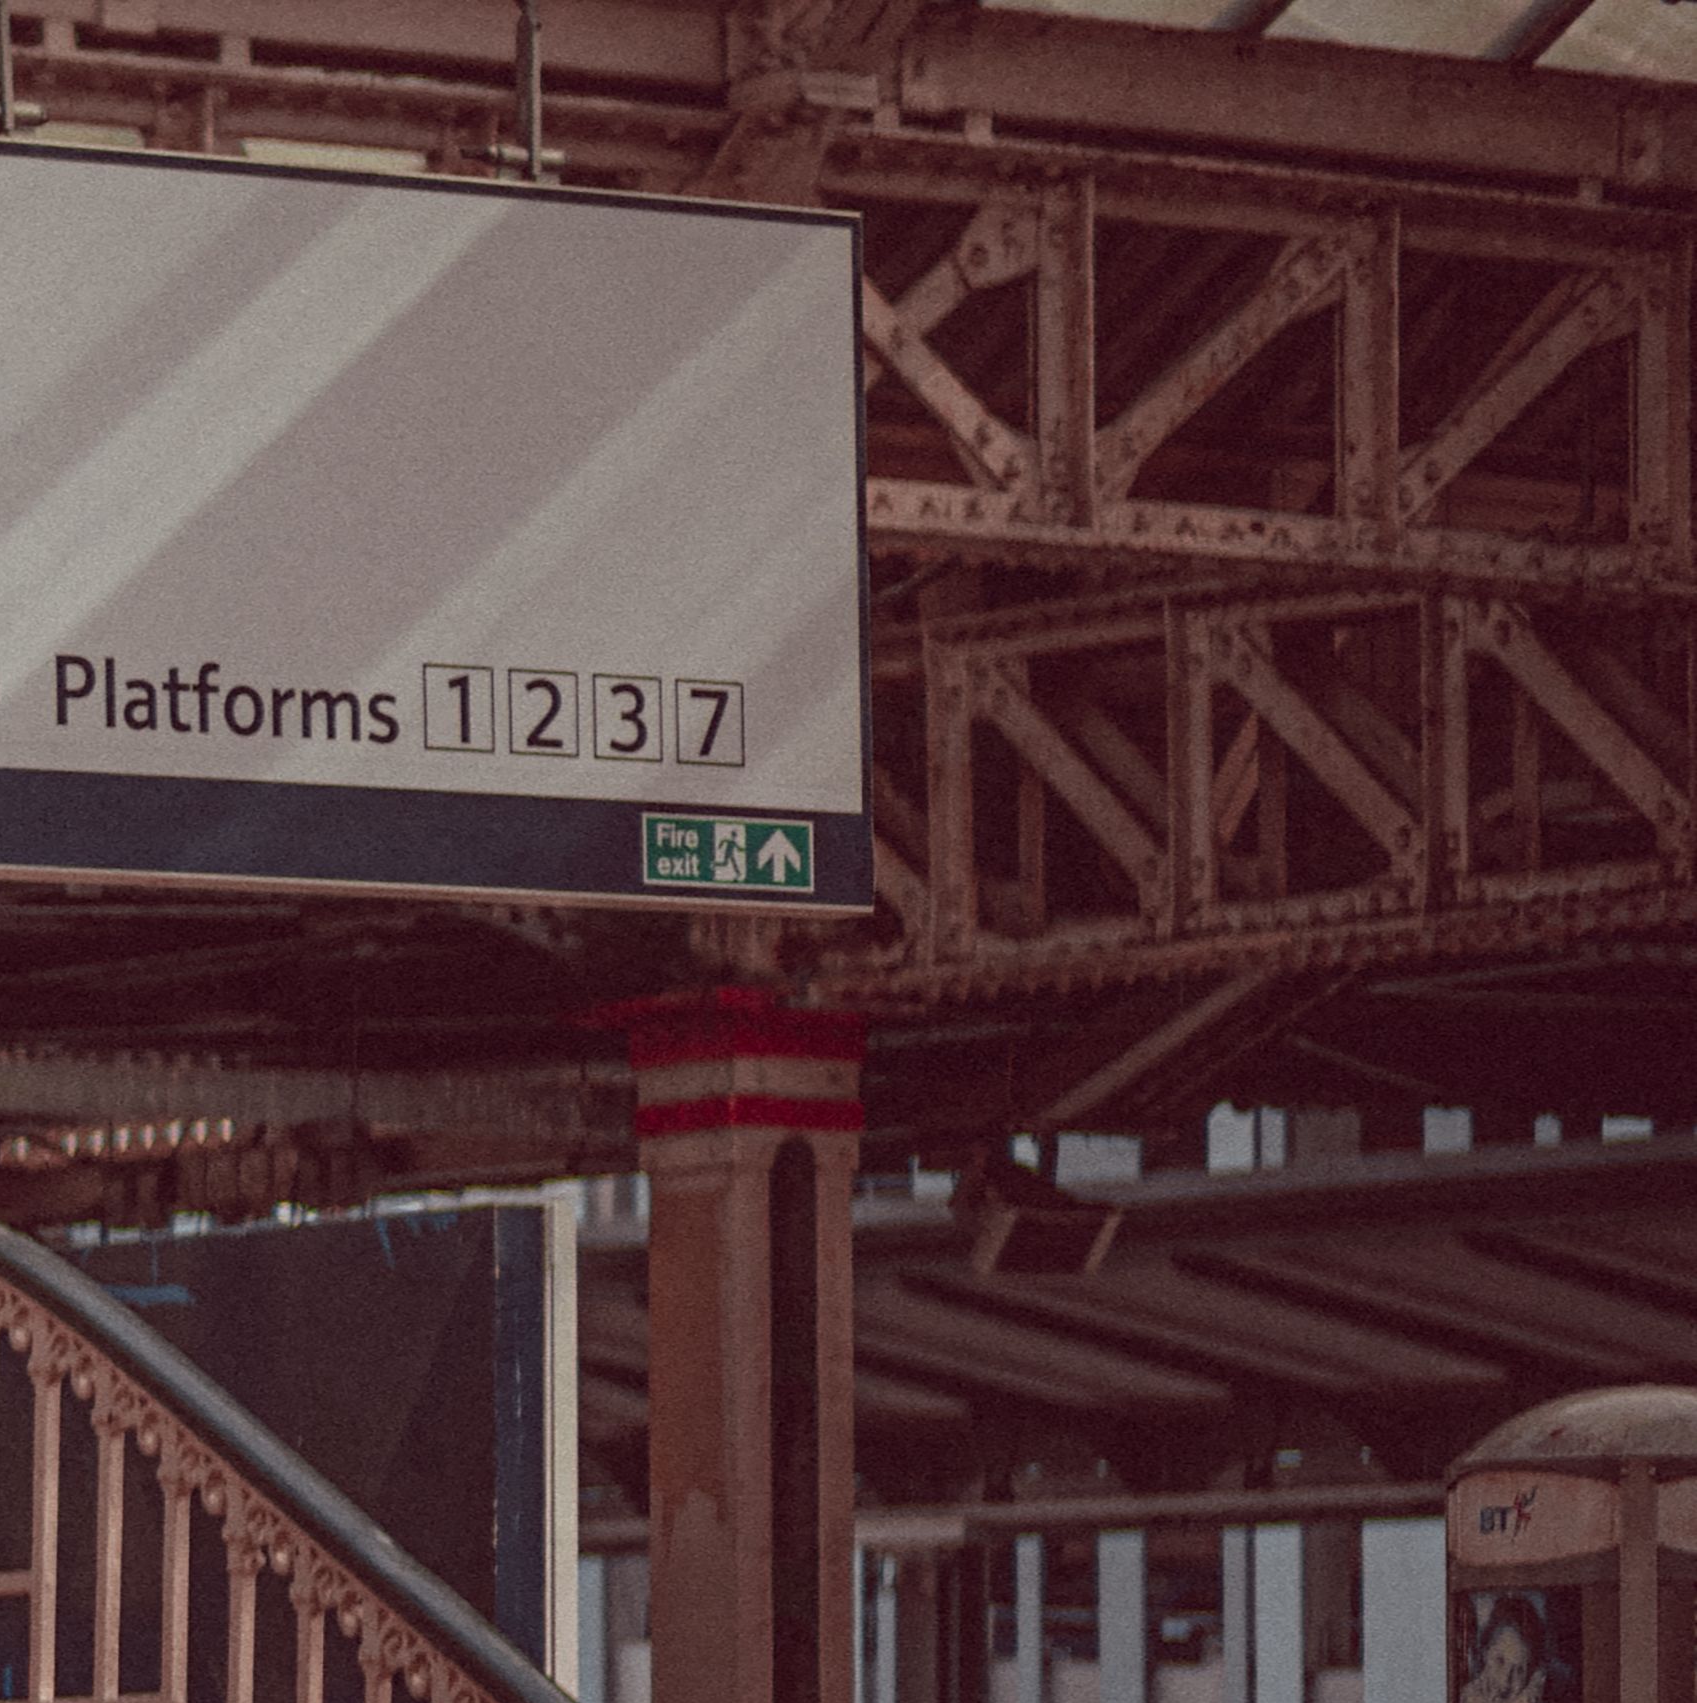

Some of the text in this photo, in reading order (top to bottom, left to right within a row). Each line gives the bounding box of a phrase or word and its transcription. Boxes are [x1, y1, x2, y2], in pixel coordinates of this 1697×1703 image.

[55, 654, 730, 756] Platforms 1 2 3 7
[656, 822, 700, 849] Fire
[657, 852, 700, 878] exit
[1480, 1506, 1513, 1535] BT
